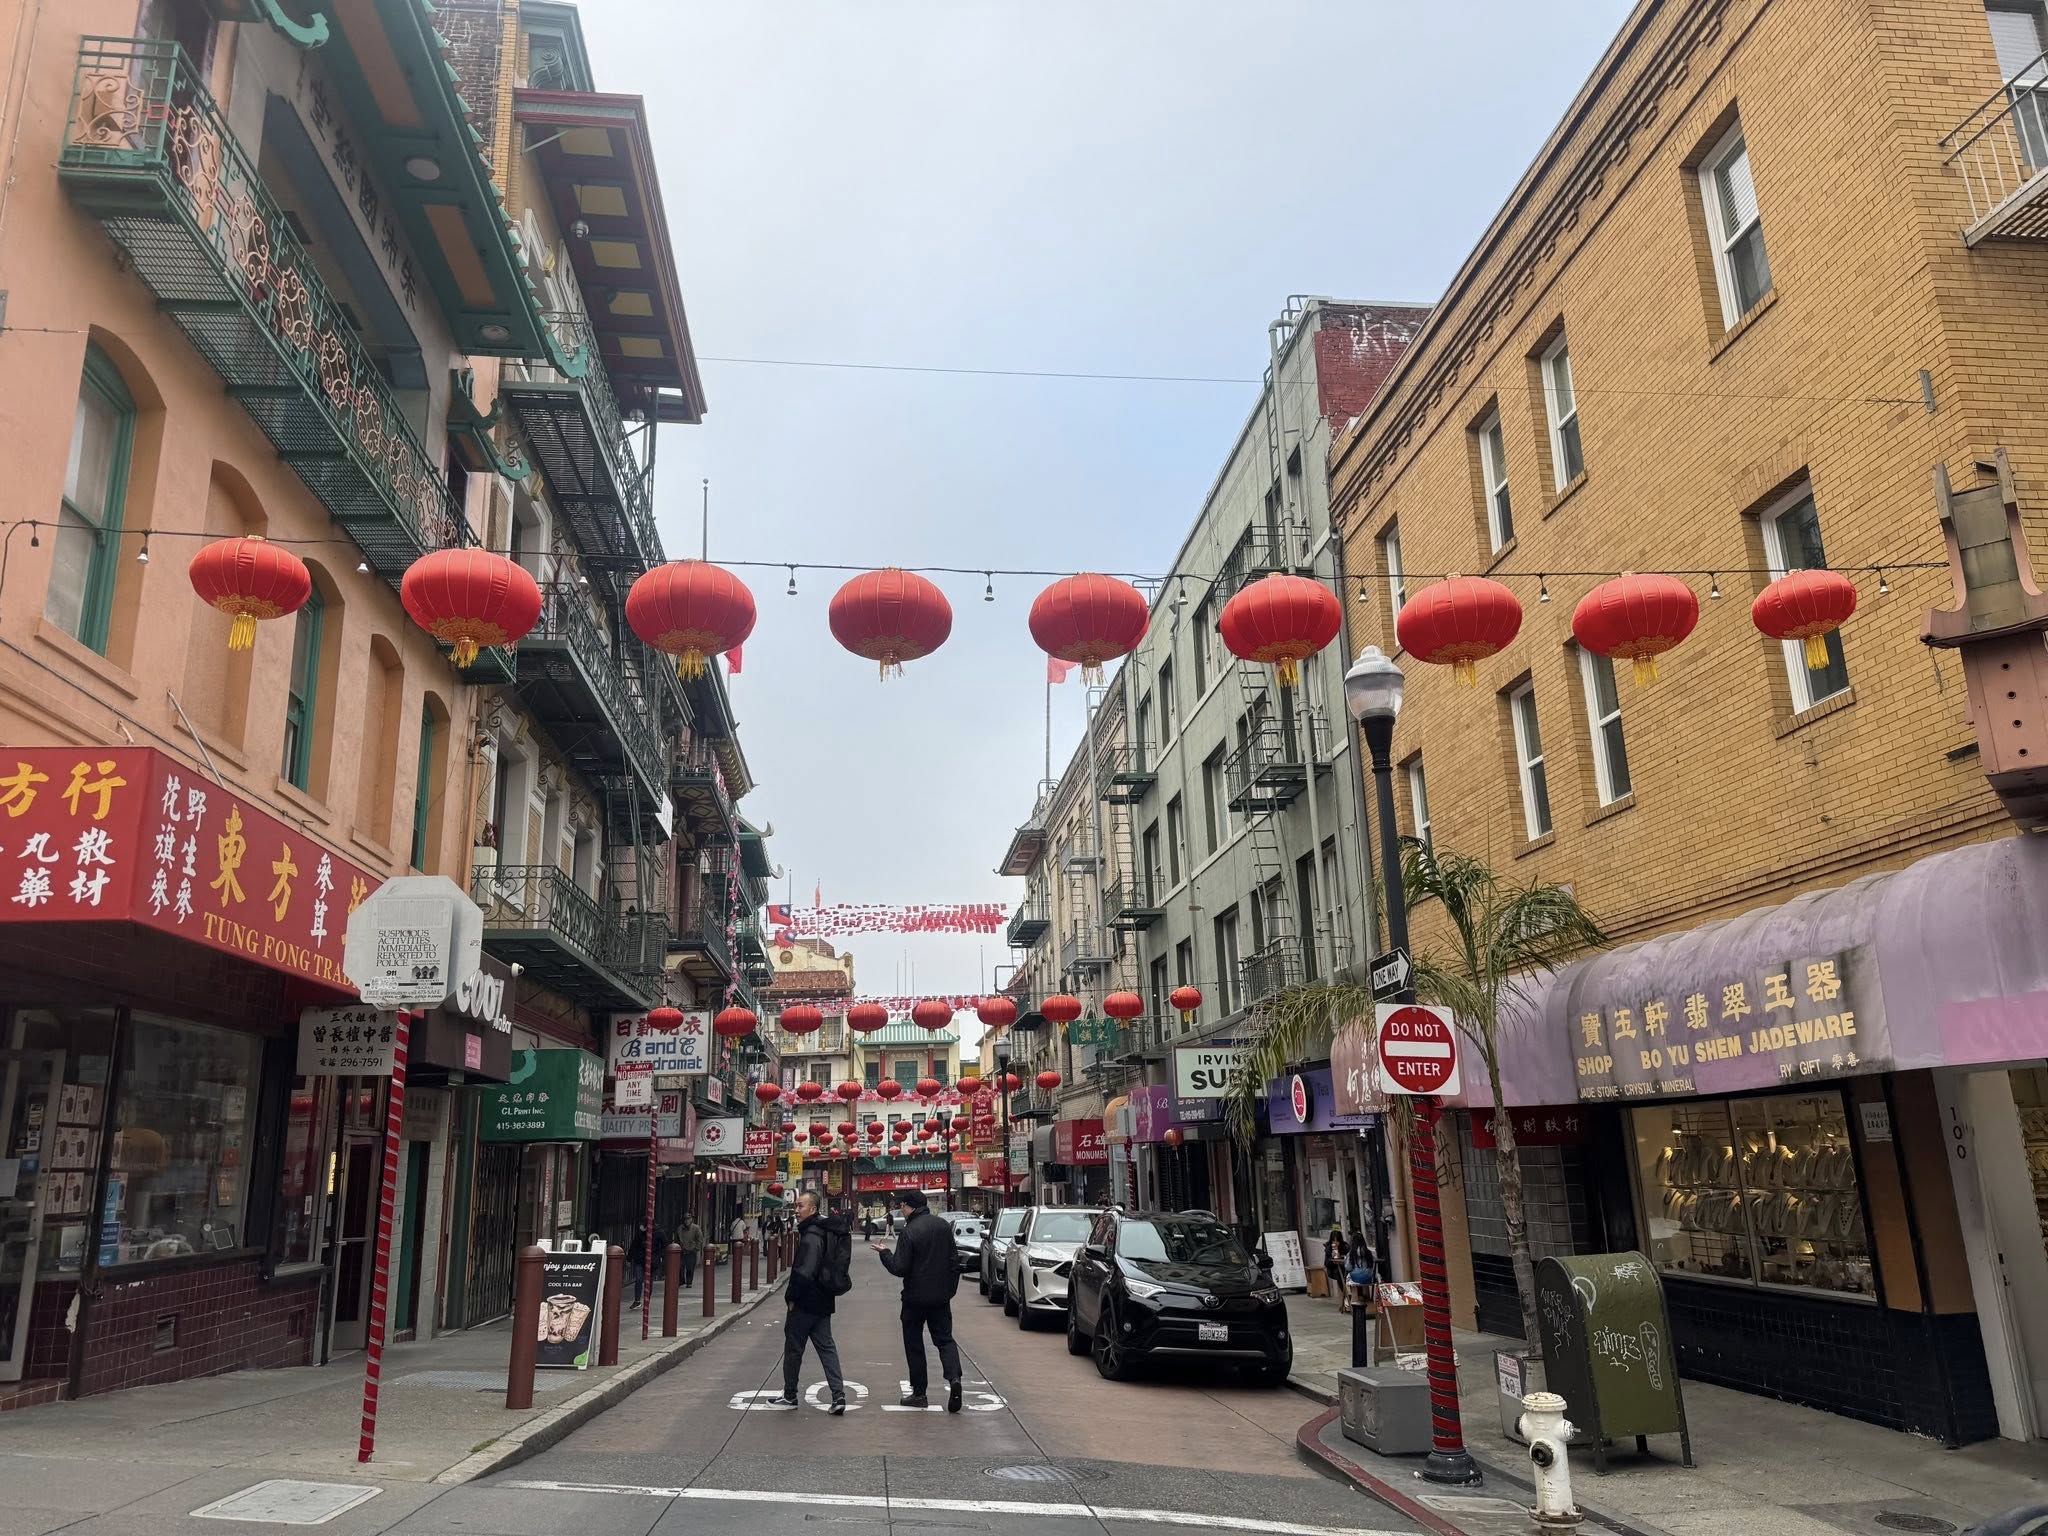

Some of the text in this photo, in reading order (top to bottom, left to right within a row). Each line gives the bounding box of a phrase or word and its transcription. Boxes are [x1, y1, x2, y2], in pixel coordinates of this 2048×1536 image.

[378, 929, 430, 938] SUSPICIOUS
[377, 937, 431, 945] ACTIVITIES
[203, 911, 356, 989] TUNG FONG TRAD
[377, 944, 439, 953] IMMEDIATELY
[376, 951, 437, 960] REPORTED TO
[1374, 963, 1400, 988] ONE WAY
[1390, 1022, 1440, 1038] DO NOT
[645, 1037, 676, 1055] and
[1577, 1011, 1857, 1076] SHOP BO YU SHEM JADEWARE
[340, 1057, 383, 1067] 296-7591
[1198, 1054, 1248, 1065] IRVIN
[1397, 1061, 1441, 1076] ENTER
[617, 1070, 653, 1080] NO STOPPING
[1579, 1087, 1596, 1099] JADE
[1596, 1085, 1620, 1098] STONE
[1624, 1081, 1656, 1096] CRYSTAL
[1660, 1078, 1696, 1093] MINERAL
[1779, 1063, 1792, 1078] RY
[1799, 1058, 1821, 1076] GIFT
[626, 1081, 641, 1089] ANY
[625, 1089, 642, 1097] TIME
[501, 1107, 513, 1116] CL
[600, 1120, 634, 1133] UALITY
[639, 1119, 679, 1132] PRTING
[1950, 1106, 1966, 1159] 100
[1076, 1150, 1108, 1160] MONUMEN
[543, 1262, 597, 1272] njoy yourself
